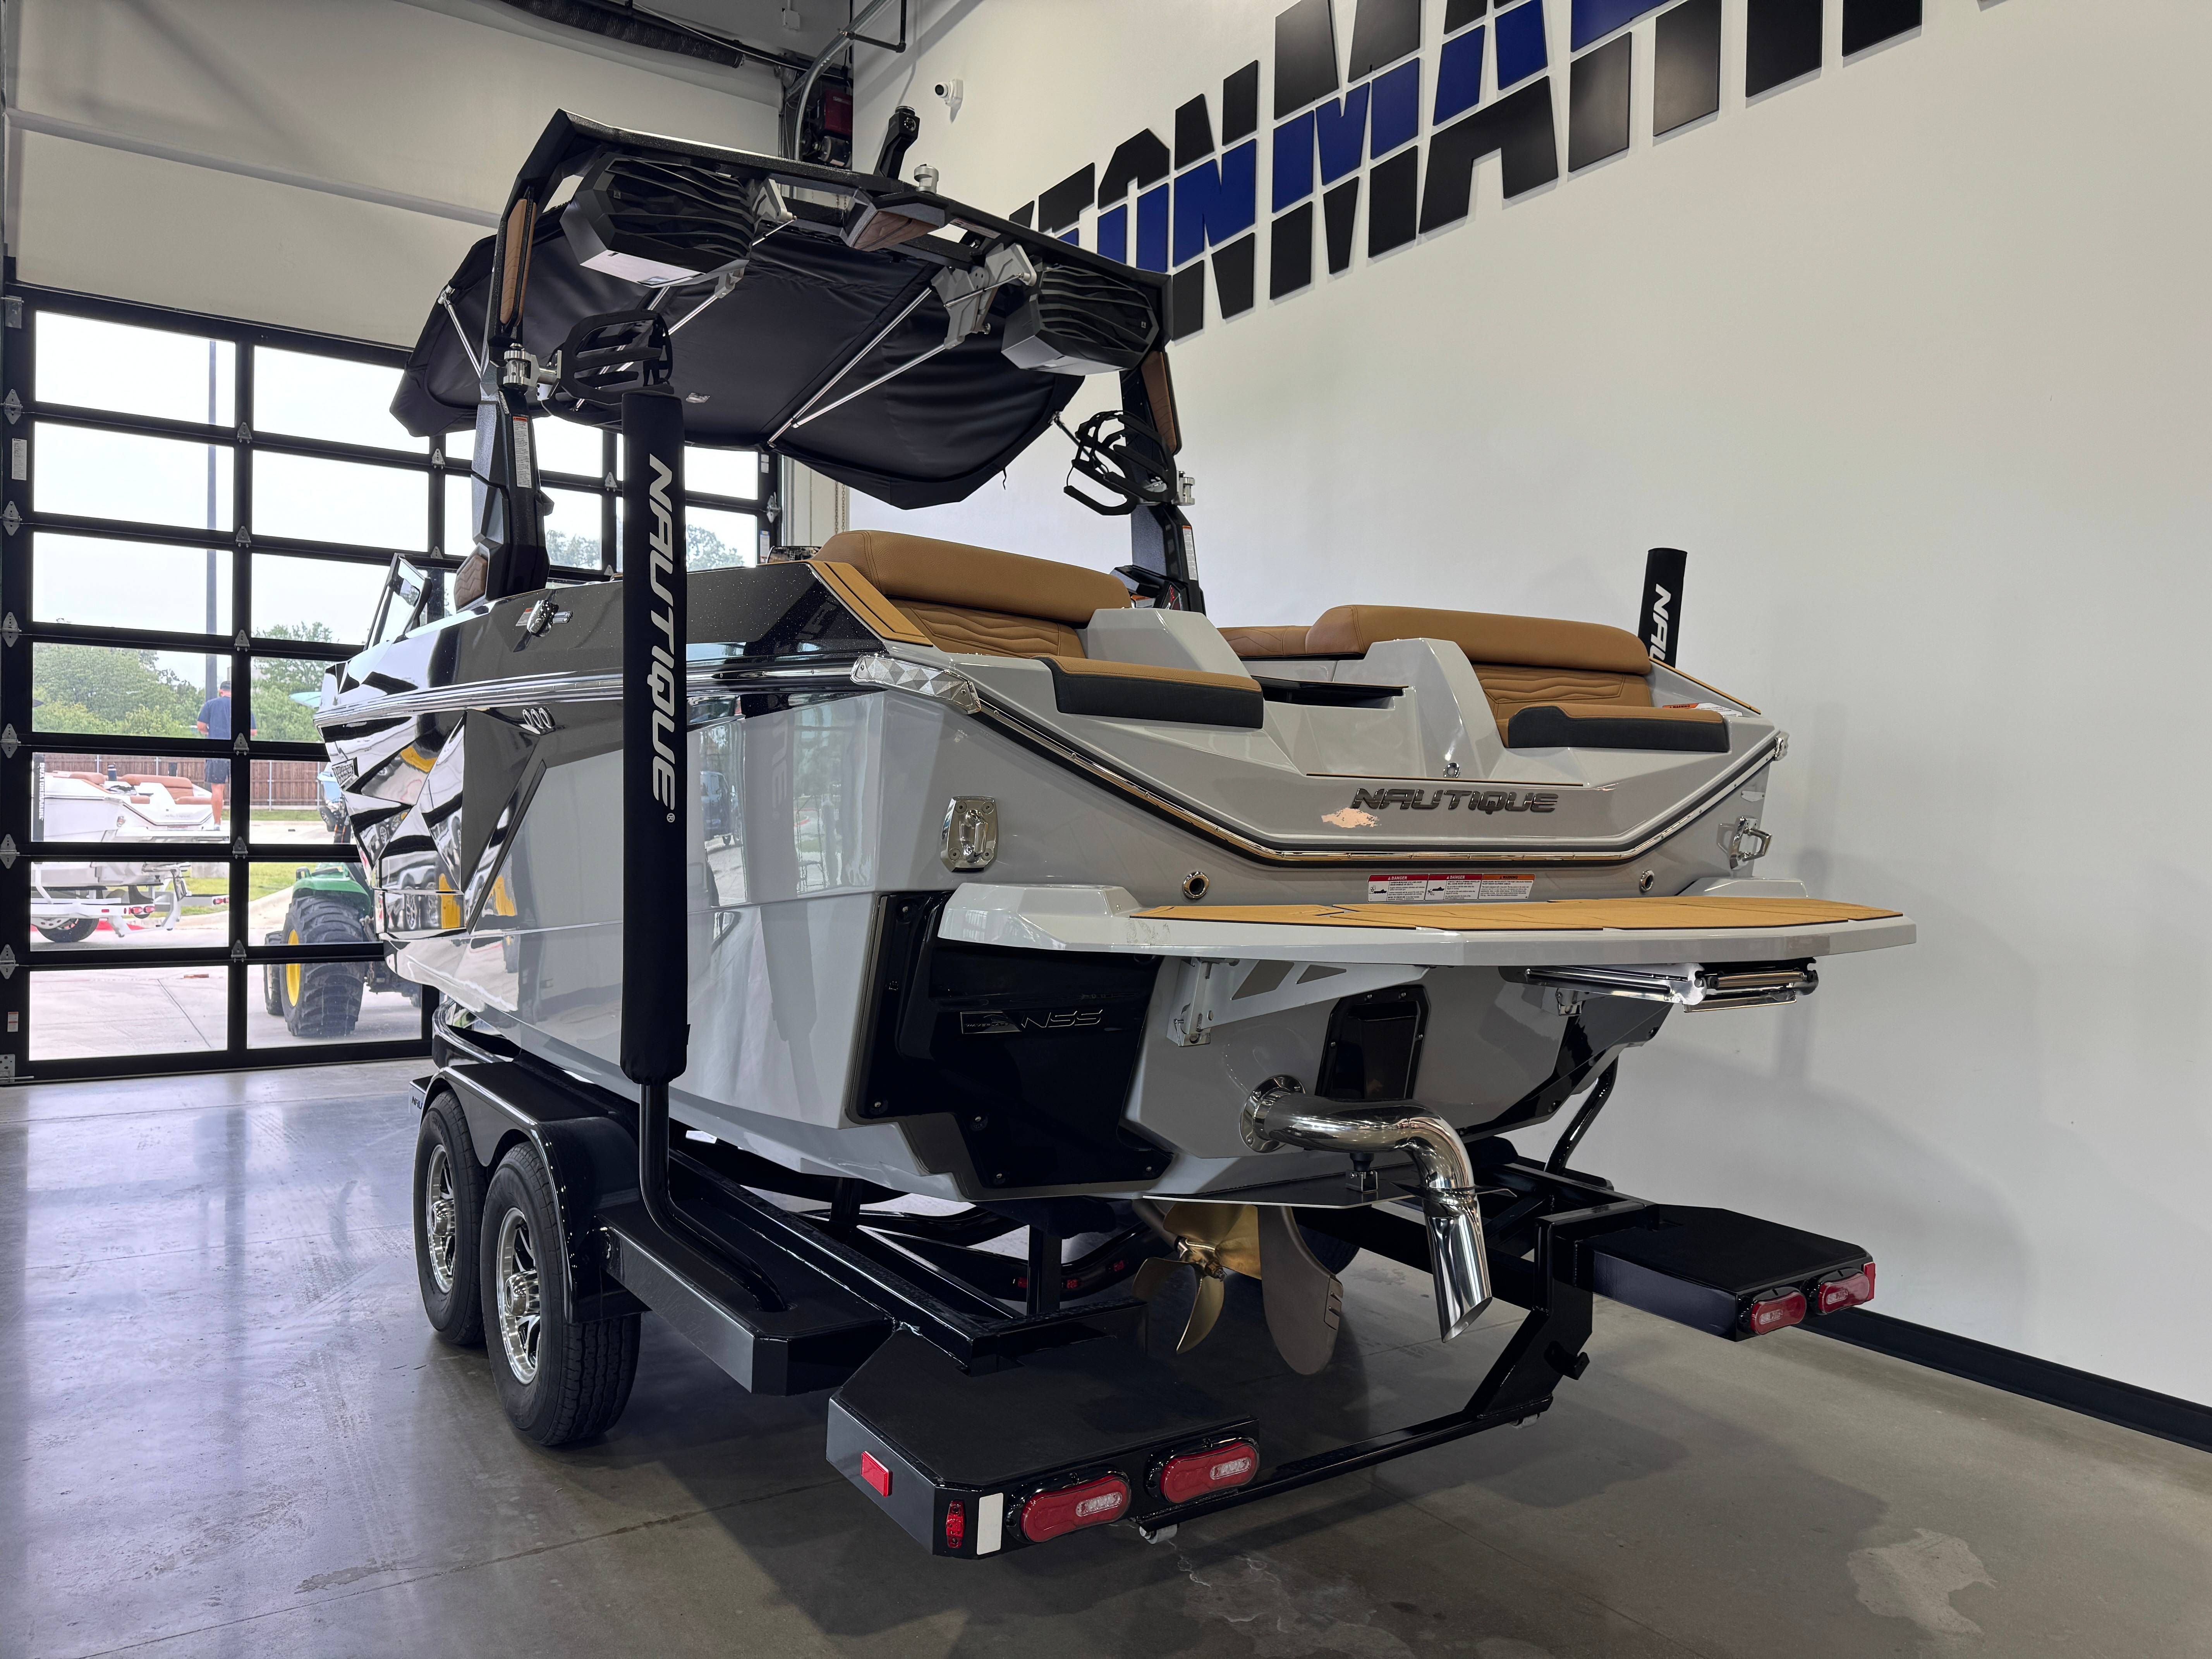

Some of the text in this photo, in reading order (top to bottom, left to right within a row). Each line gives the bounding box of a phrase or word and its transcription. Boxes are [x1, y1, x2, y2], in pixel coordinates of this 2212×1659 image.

[1350, 788, 1559, 815] NAUTIQUE
[1021, 1009, 1103, 1028] NSS
[412, 1096, 423, 1109] NAU
